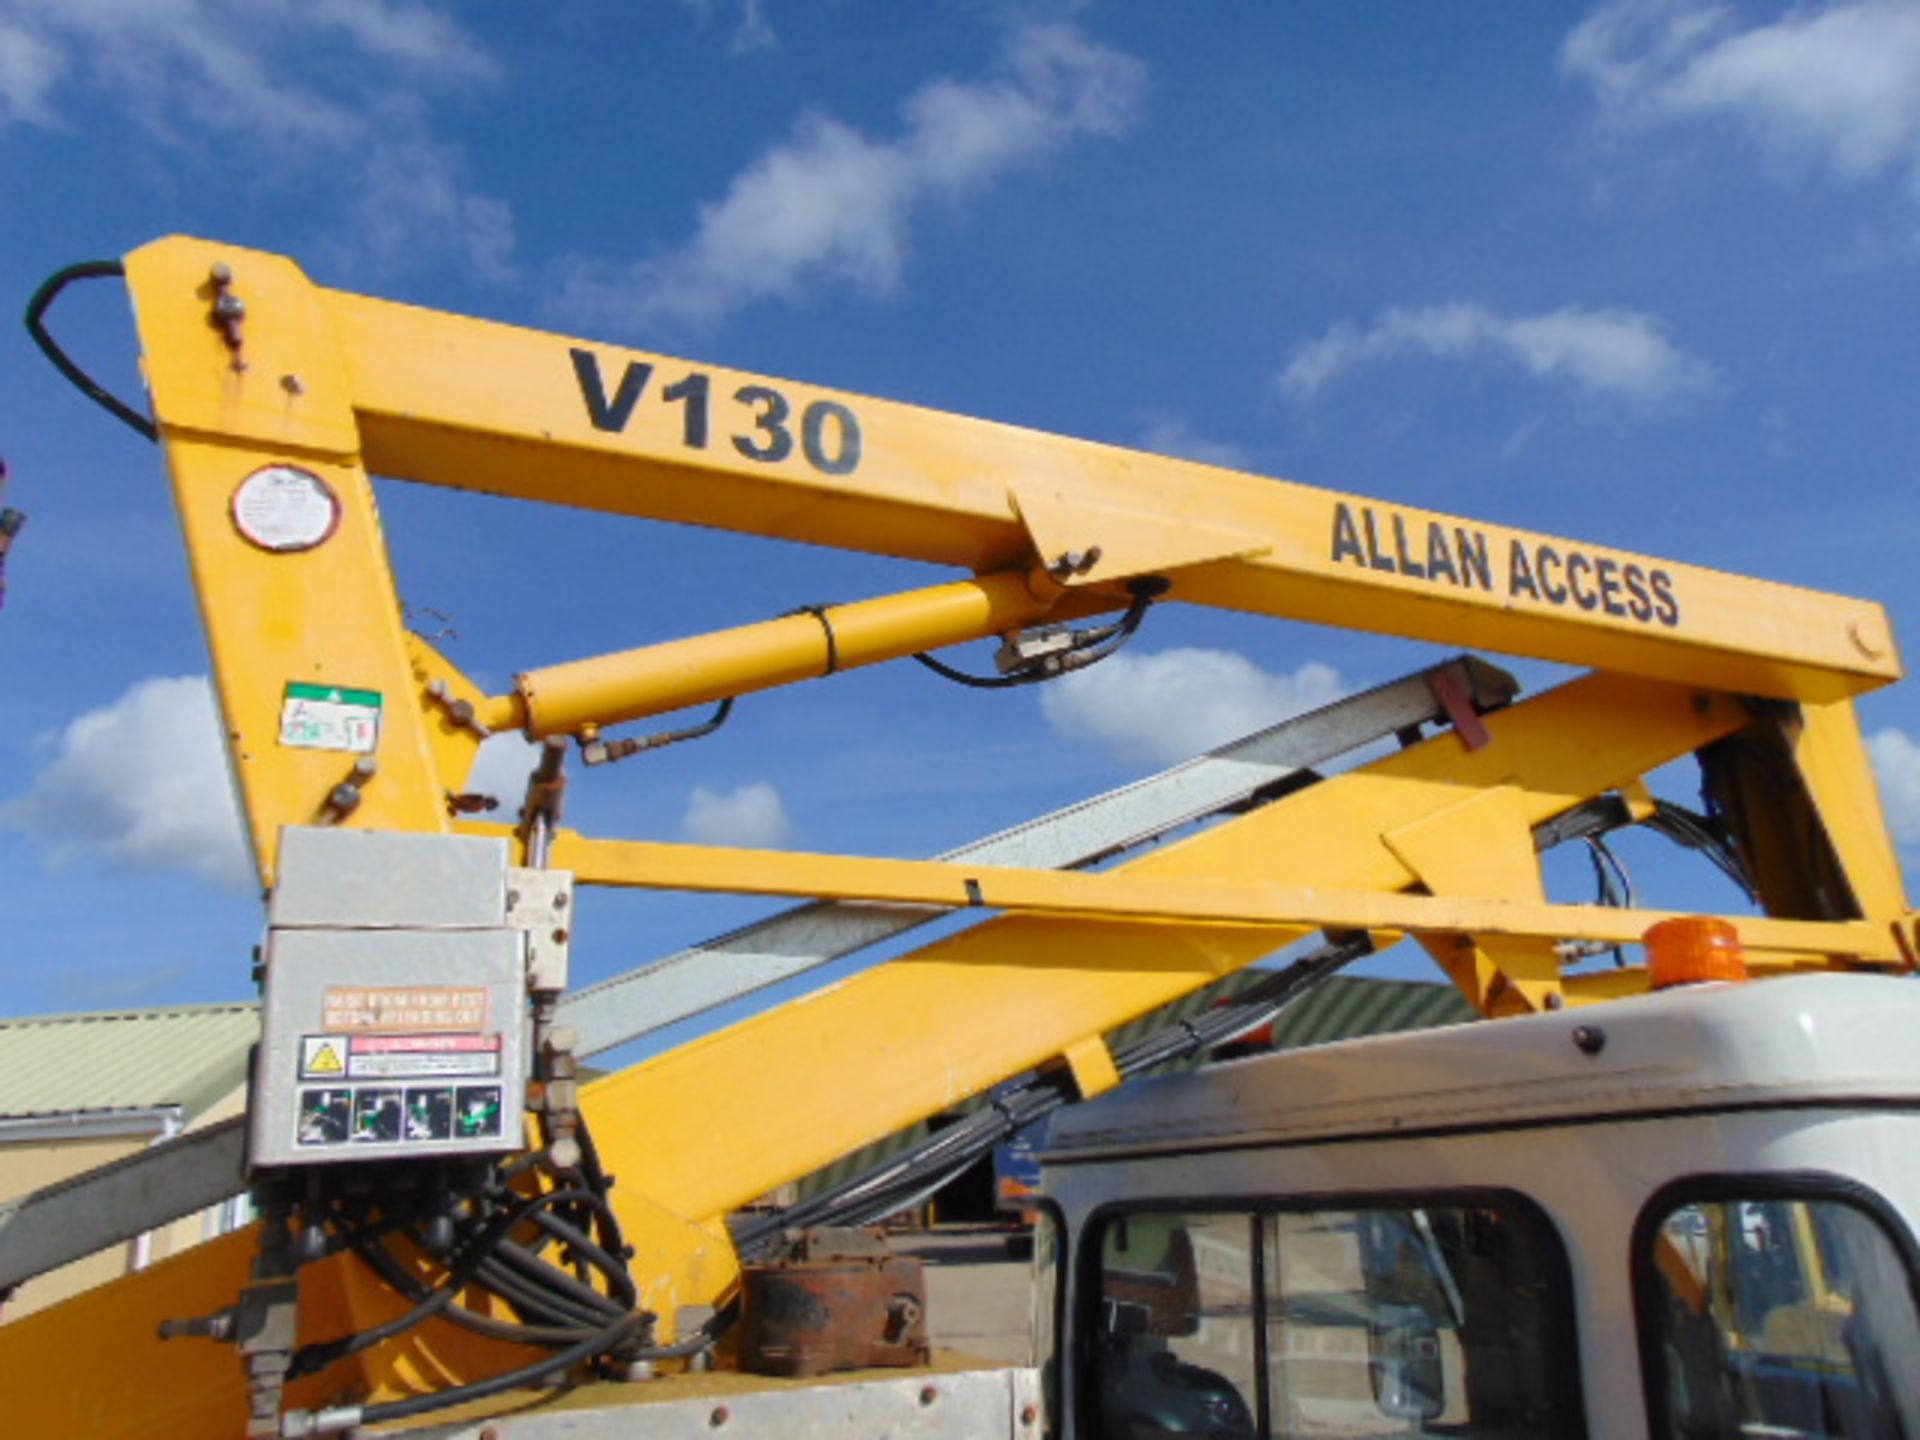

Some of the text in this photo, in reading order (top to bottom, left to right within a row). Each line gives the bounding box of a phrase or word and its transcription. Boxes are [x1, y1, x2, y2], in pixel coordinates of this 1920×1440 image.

[569, 347, 861, 475] V130
[1331, 502, 1679, 627] ALLAN ACCESS
